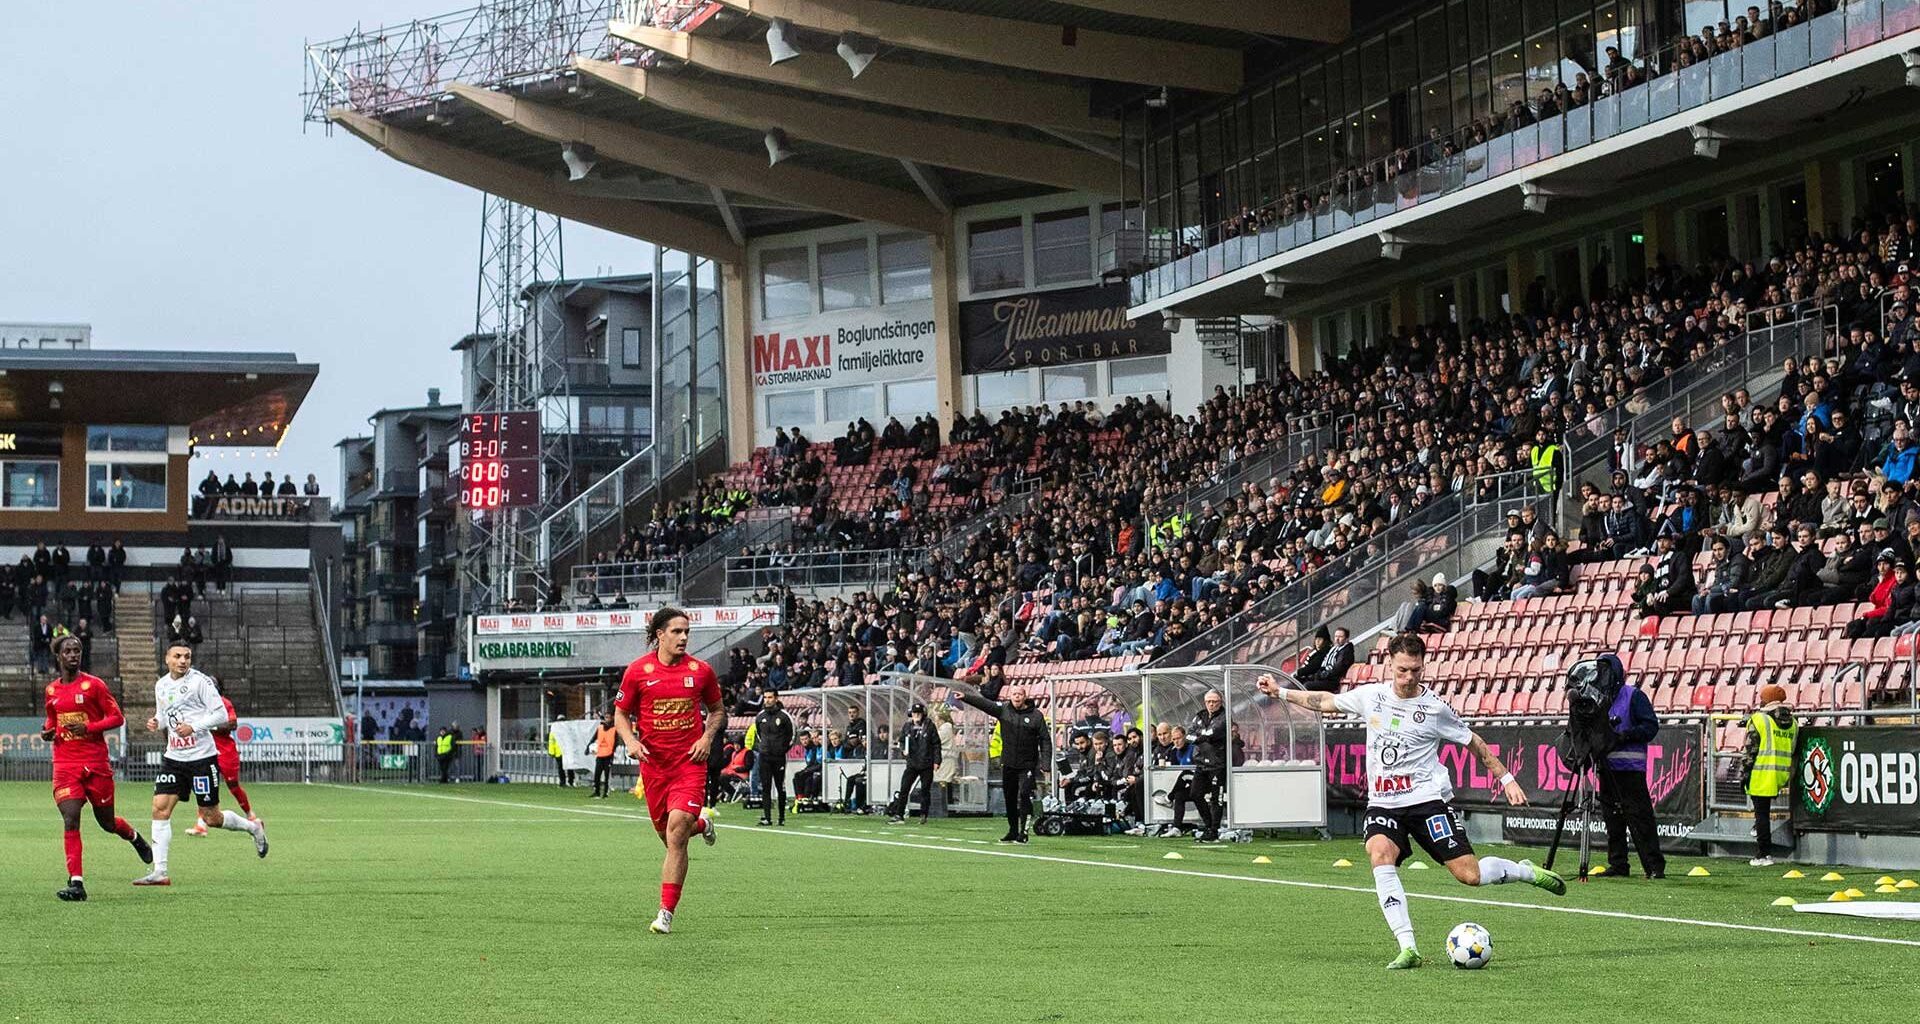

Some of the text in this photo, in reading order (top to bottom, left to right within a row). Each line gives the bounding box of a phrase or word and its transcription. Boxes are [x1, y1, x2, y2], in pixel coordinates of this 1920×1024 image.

[838, 320, 936, 346] Boglundsängen
[754, 333, 831, 374] MAXI
[838, 348, 924, 372] familjeläktare
[1008, 338, 1138, 366] SPORTBAR
[768, 367, 832, 385] STORMARKNAD
[461, 418, 470, 432] A
[501, 416, 508, 430] E
[461, 442, 470, 456] B
[501, 441, 508, 455] F
[461, 465, 470, 480] C
[501, 464, 510, 478] G
[461, 490, 470, 504] D
[501, 489, 510, 503] H
[479, 641, 572, 659] KEBABFABRIKEN
[1840, 741, 1920, 804] ÖREB
[1657, 822, 1694, 837] OFILKLÄD
